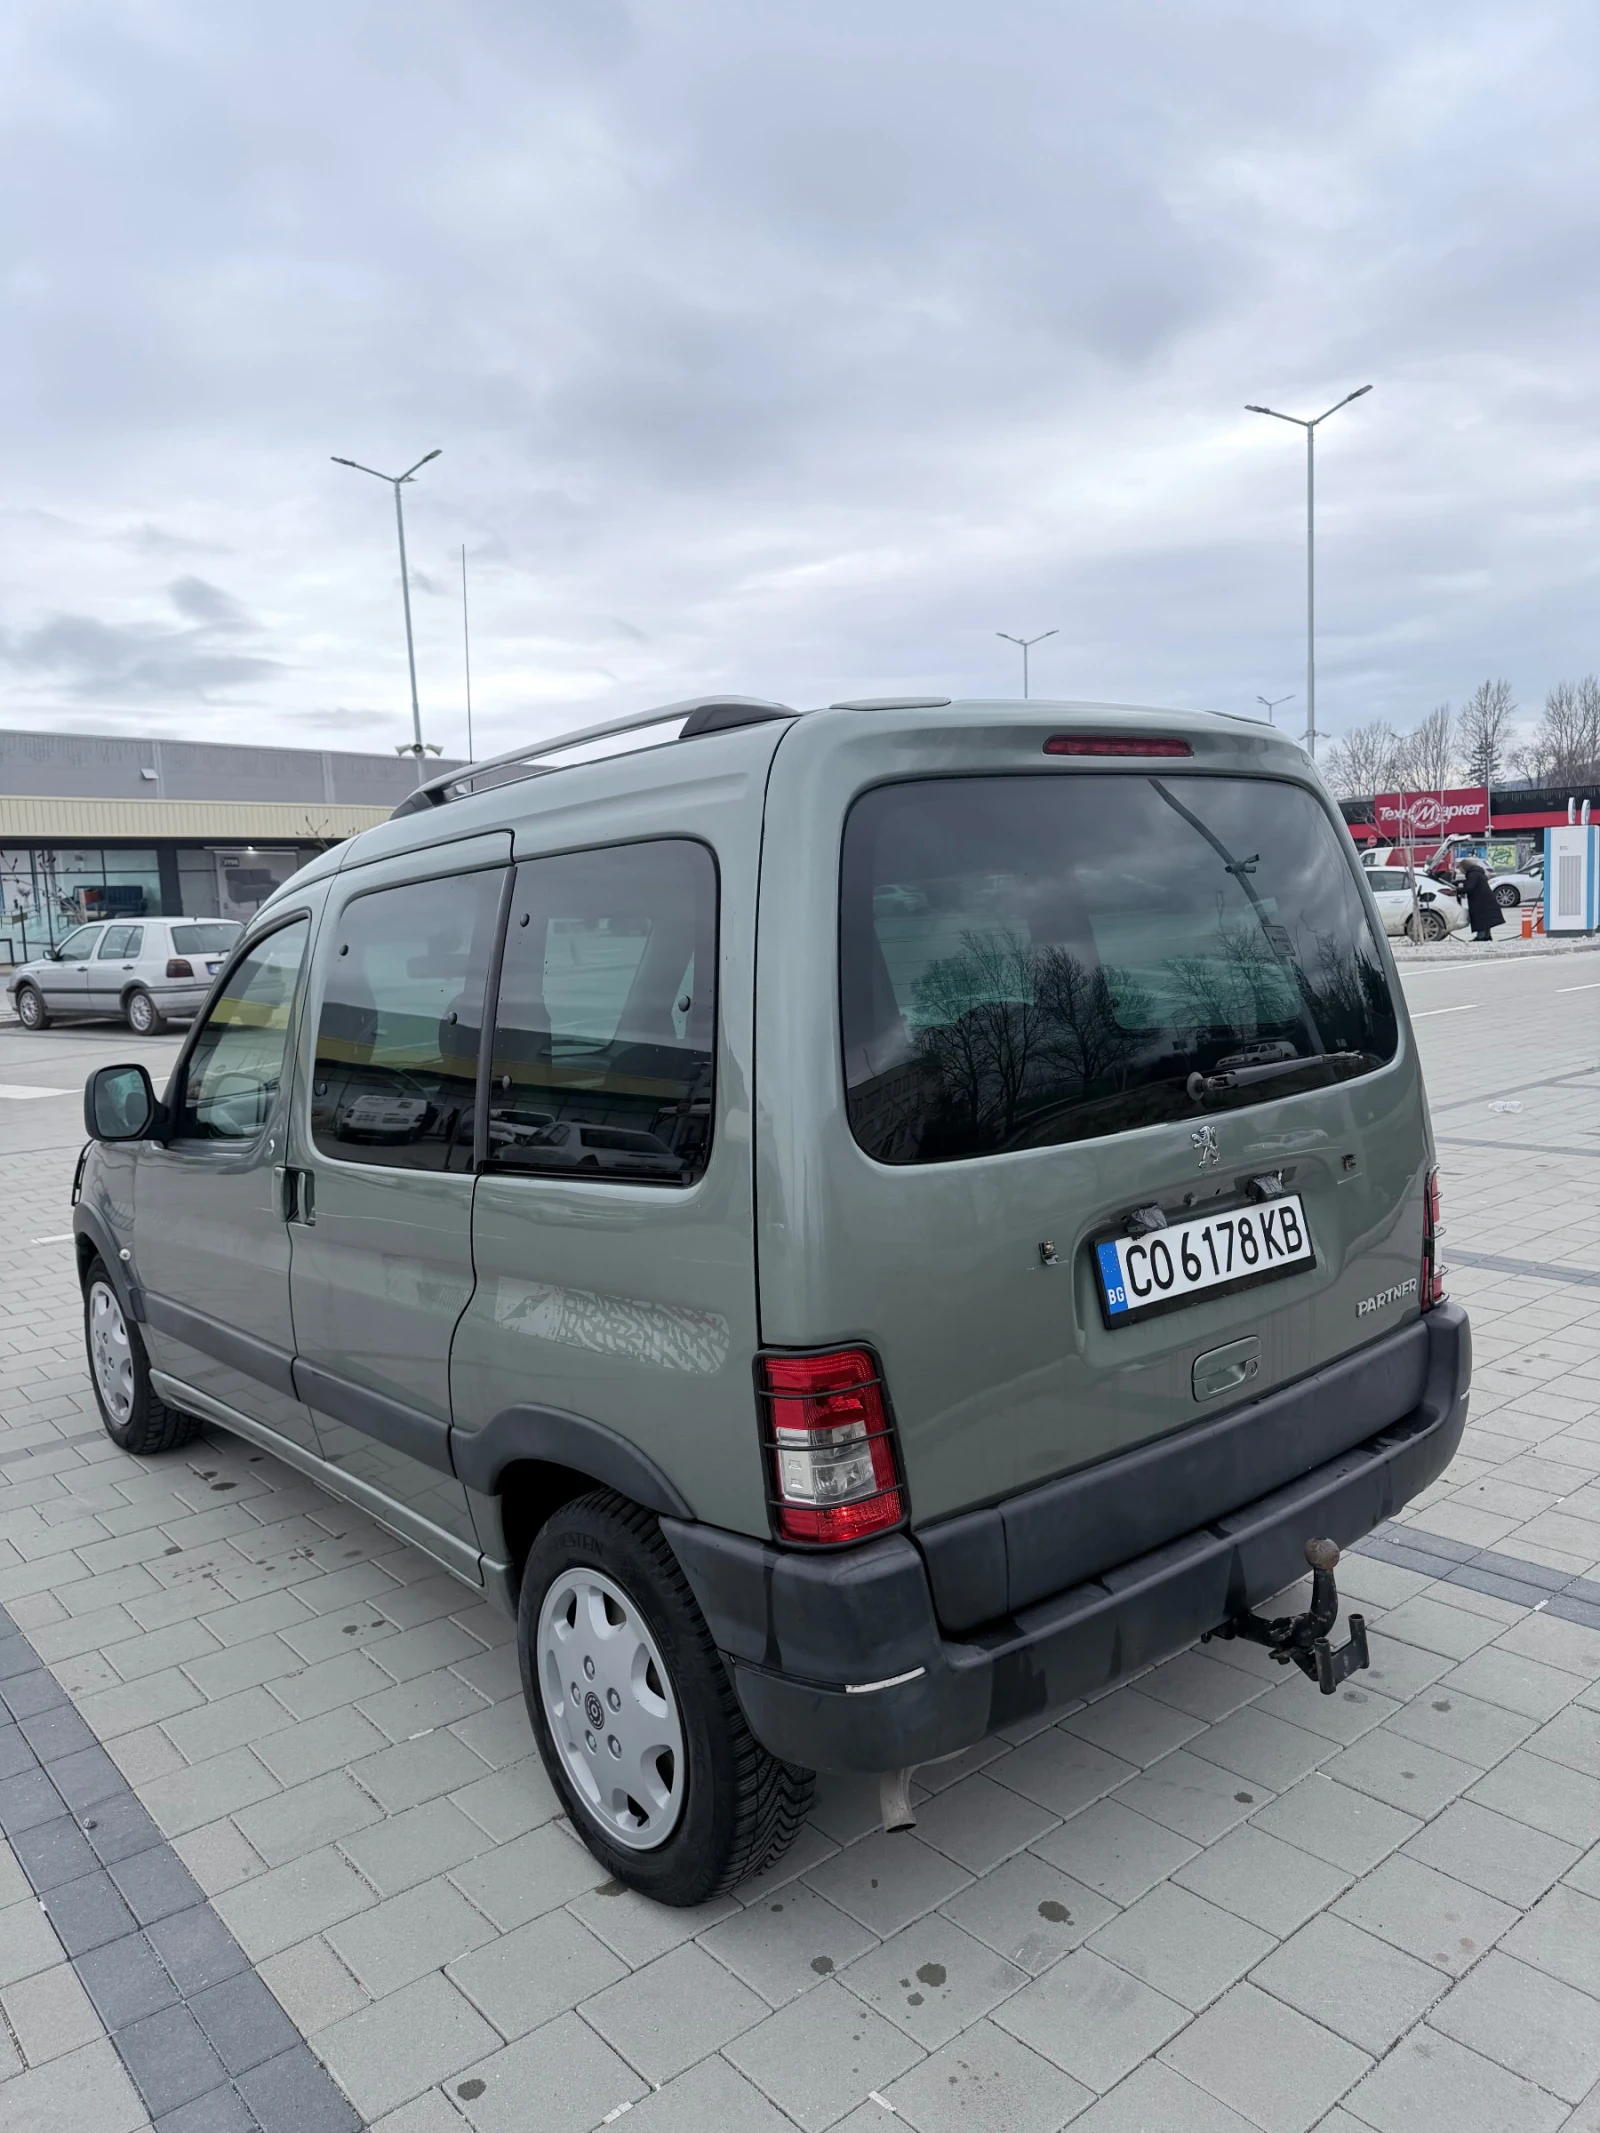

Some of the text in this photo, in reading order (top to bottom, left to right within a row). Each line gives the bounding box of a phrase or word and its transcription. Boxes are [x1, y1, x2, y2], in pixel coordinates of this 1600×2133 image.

[1181, 1217, 1259, 1282] 6178
[1259, 1205, 1303, 1260] KB
[1107, 1286, 1125, 1305] BG
[1356, 1277, 1417, 1317] PARTNER
